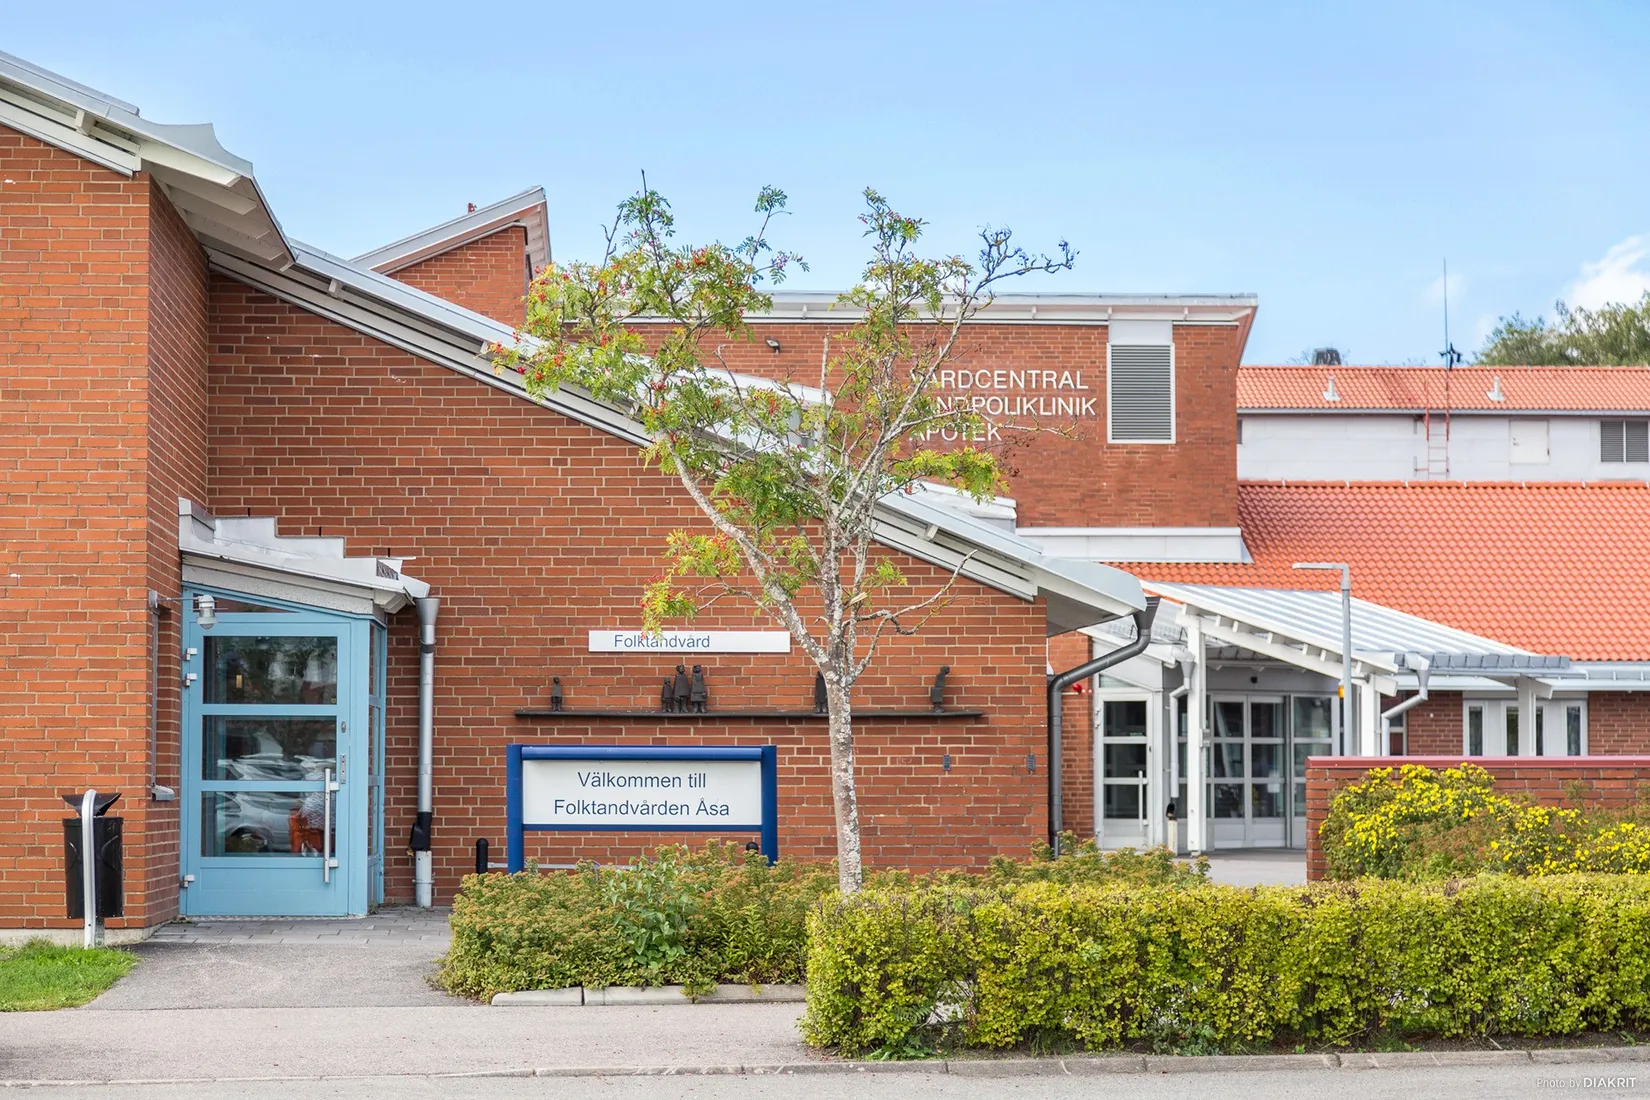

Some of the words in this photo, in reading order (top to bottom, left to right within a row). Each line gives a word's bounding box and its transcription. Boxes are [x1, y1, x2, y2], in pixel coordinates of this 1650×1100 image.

[614, 634, 710, 648] Folktandvård
[577, 772, 682, 788] Välkommen
[688, 773, 706, 788] till
[554, 799, 690, 815] Folktandvården
[696, 798, 730, 816] Åsa
